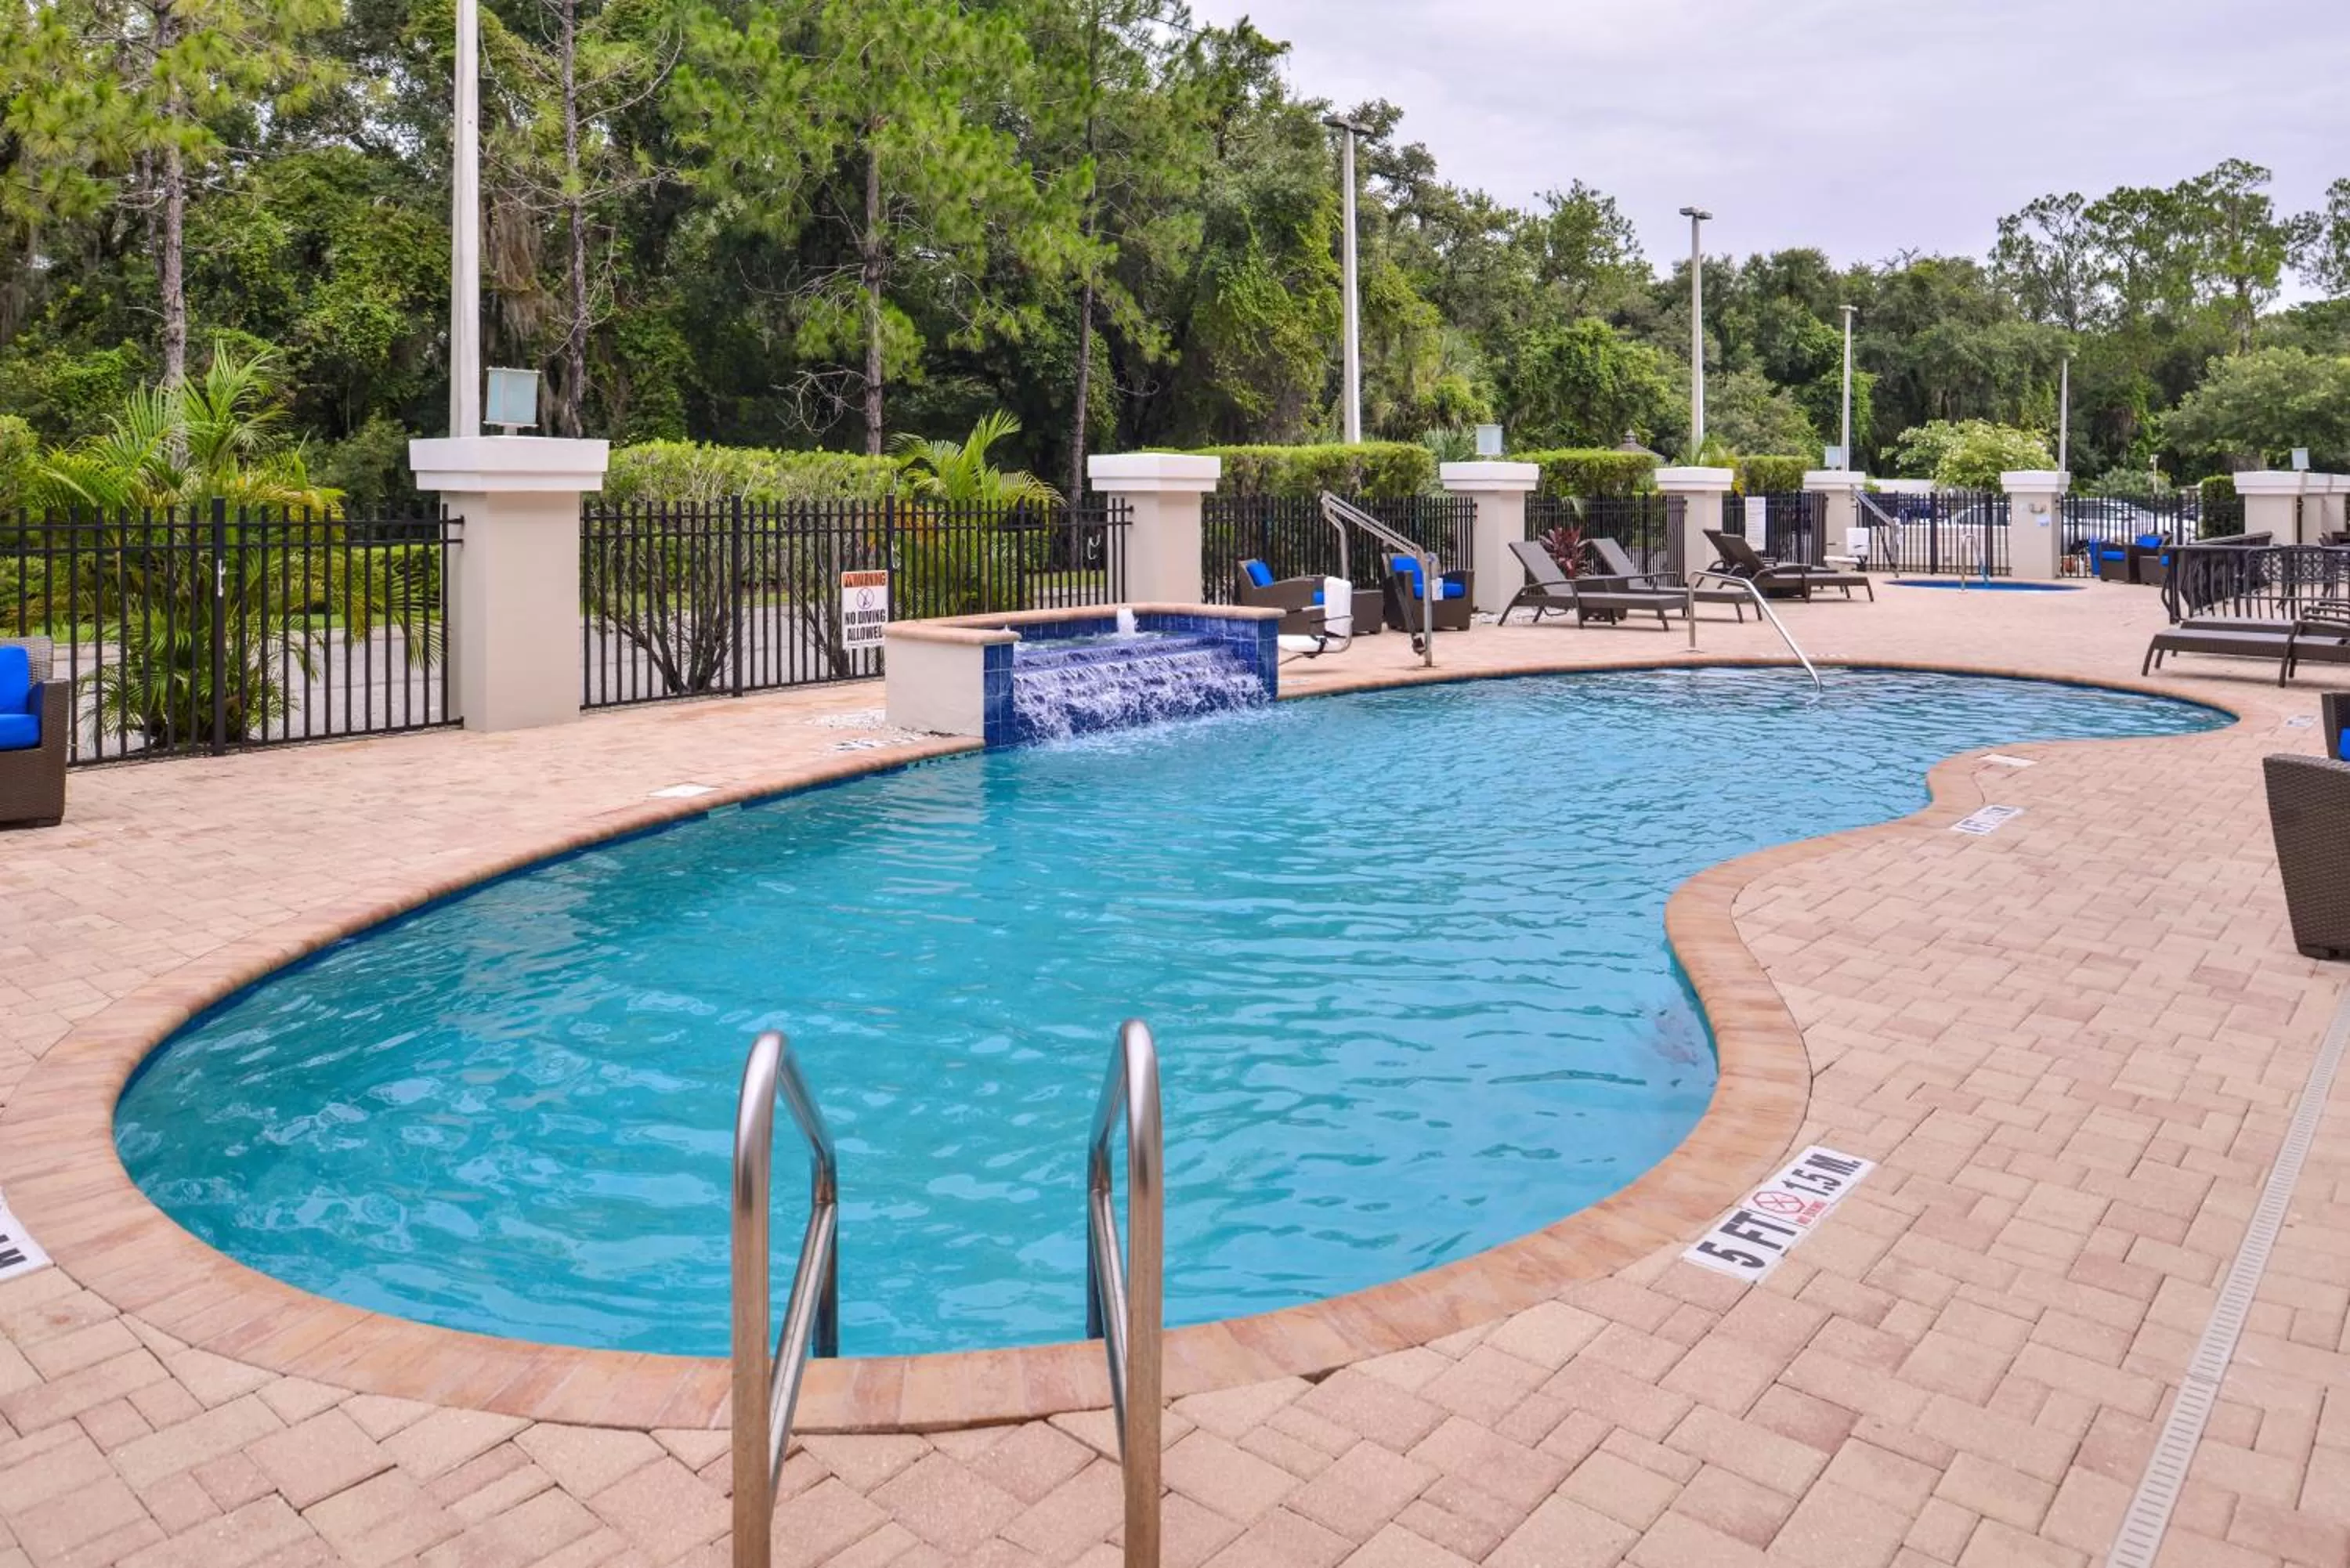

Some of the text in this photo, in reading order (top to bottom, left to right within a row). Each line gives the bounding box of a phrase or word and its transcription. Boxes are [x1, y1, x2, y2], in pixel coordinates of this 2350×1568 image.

[844, 609, 886, 625] NO DIVING
[1719, 1210, 1797, 1251] FT
[1696, 1241, 1766, 1269] 5
